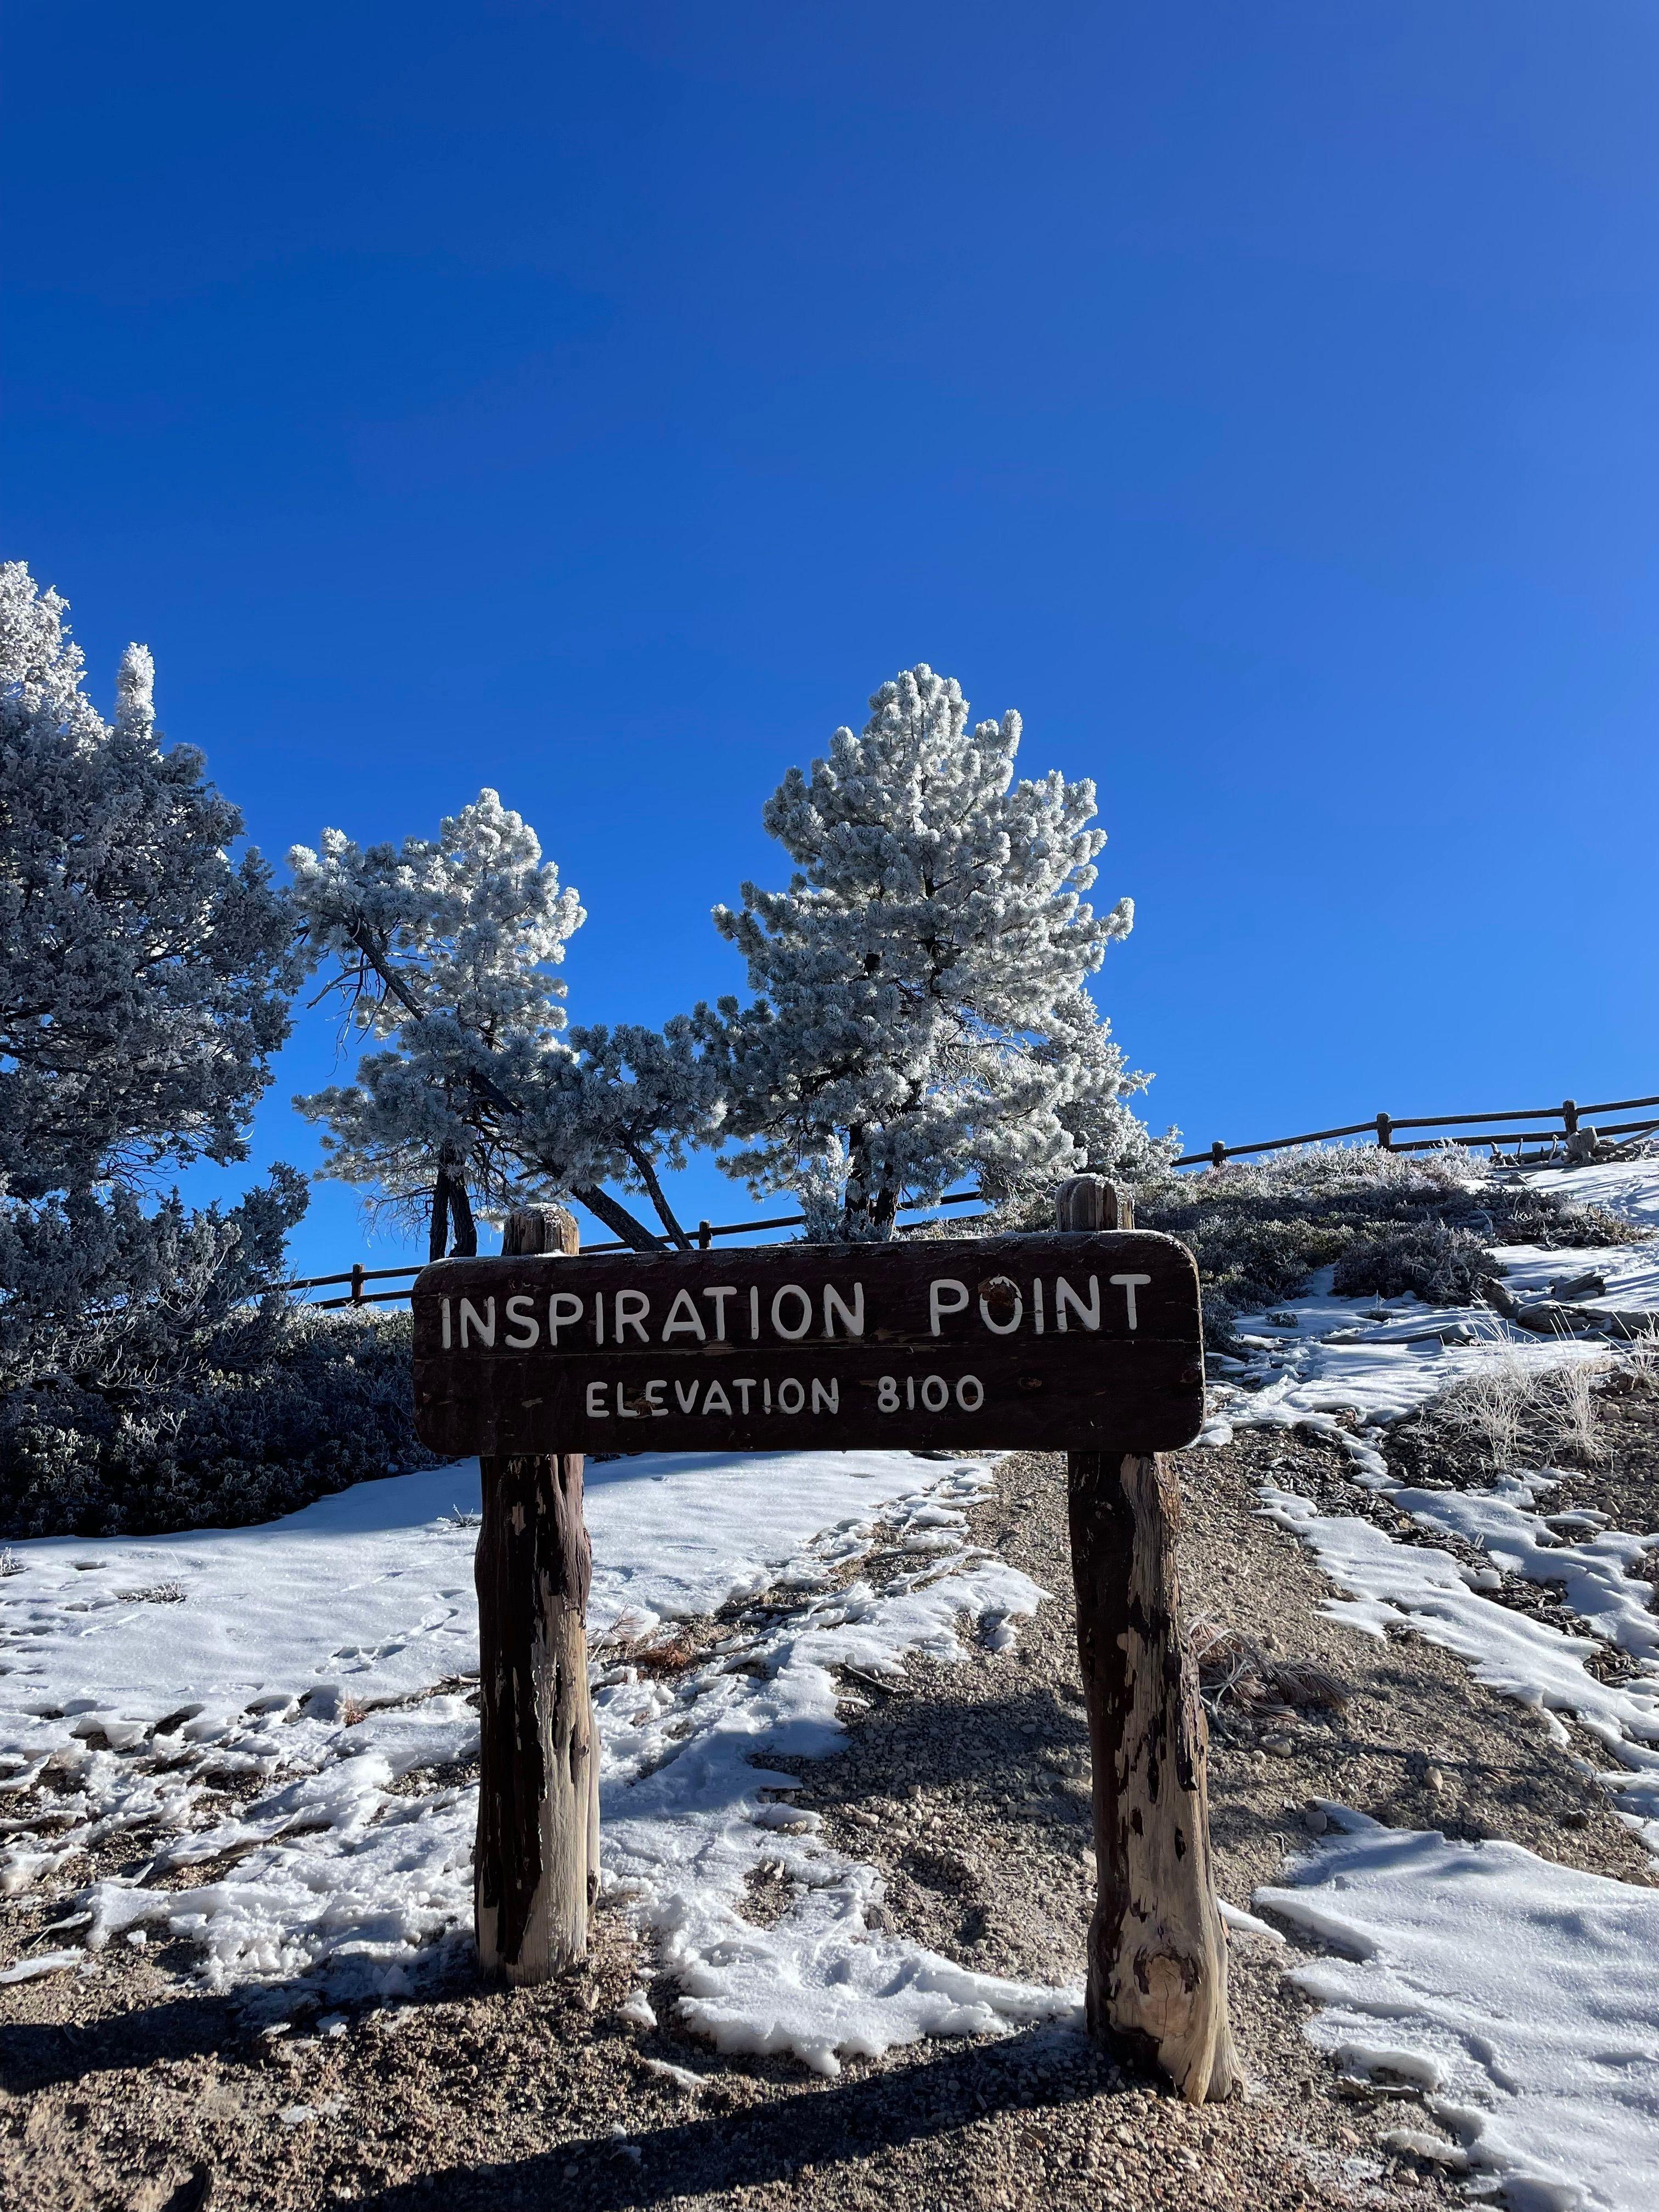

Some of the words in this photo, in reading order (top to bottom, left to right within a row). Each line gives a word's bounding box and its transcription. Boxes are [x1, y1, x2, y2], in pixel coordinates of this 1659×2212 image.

[441, 1282, 865, 1349] INSPIRATION
[929, 1274, 1152, 1337] POINT
[586, 1378, 839, 1418] ELEVATION
[877, 1374, 984, 1413] 8100
